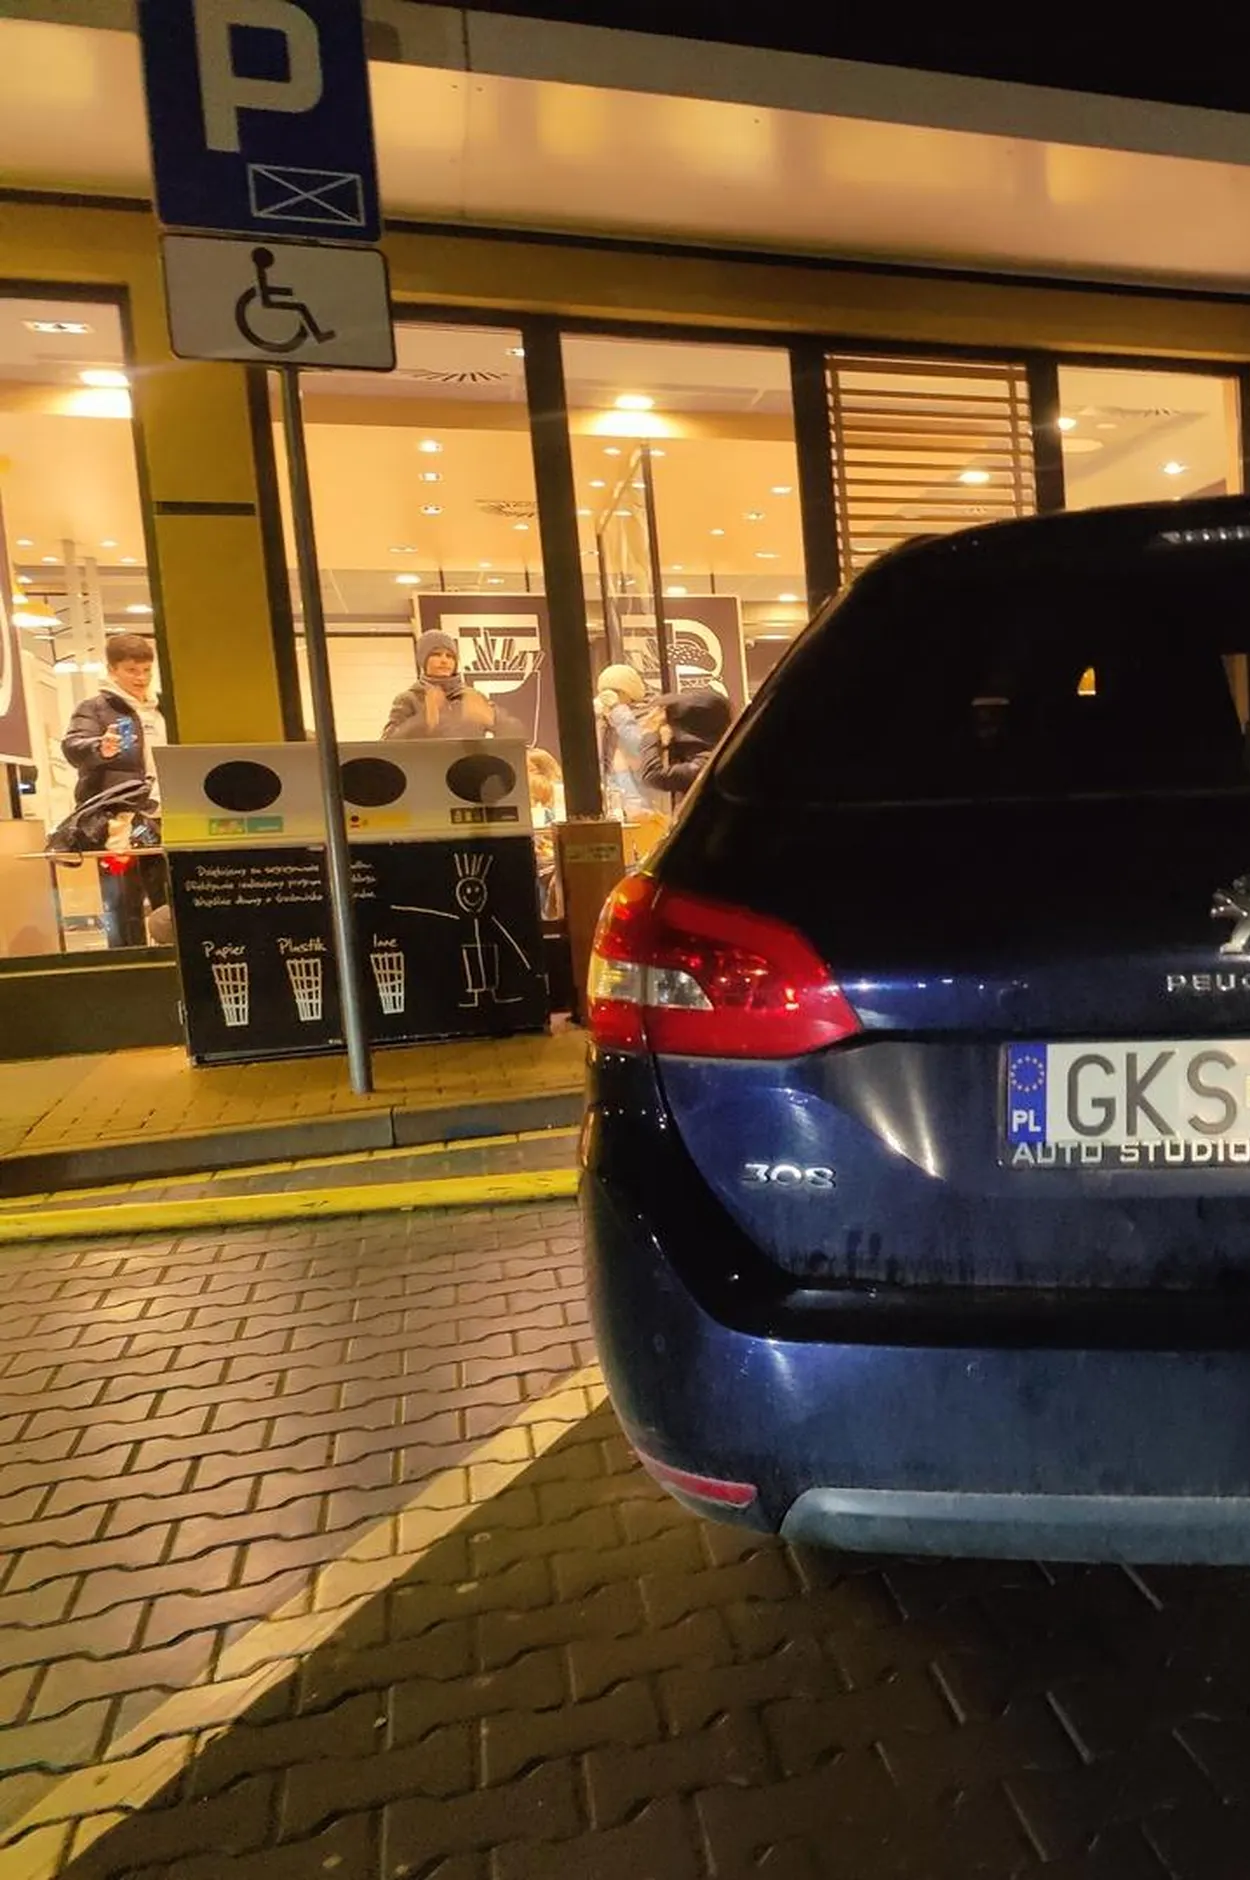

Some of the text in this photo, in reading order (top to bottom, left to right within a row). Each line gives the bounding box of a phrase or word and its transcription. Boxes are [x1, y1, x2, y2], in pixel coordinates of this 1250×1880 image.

[194, 0, 323, 152] P
[202, 941, 246, 958] Papier
[1066, 1049, 1238, 1137] GKS
[1012, 1109, 1041, 1132] PL
[1012, 1141, 1104, 1165] AUTO
[1120, 1138, 1250, 1162] STUDIO
[744, 1163, 835, 1189] 308
